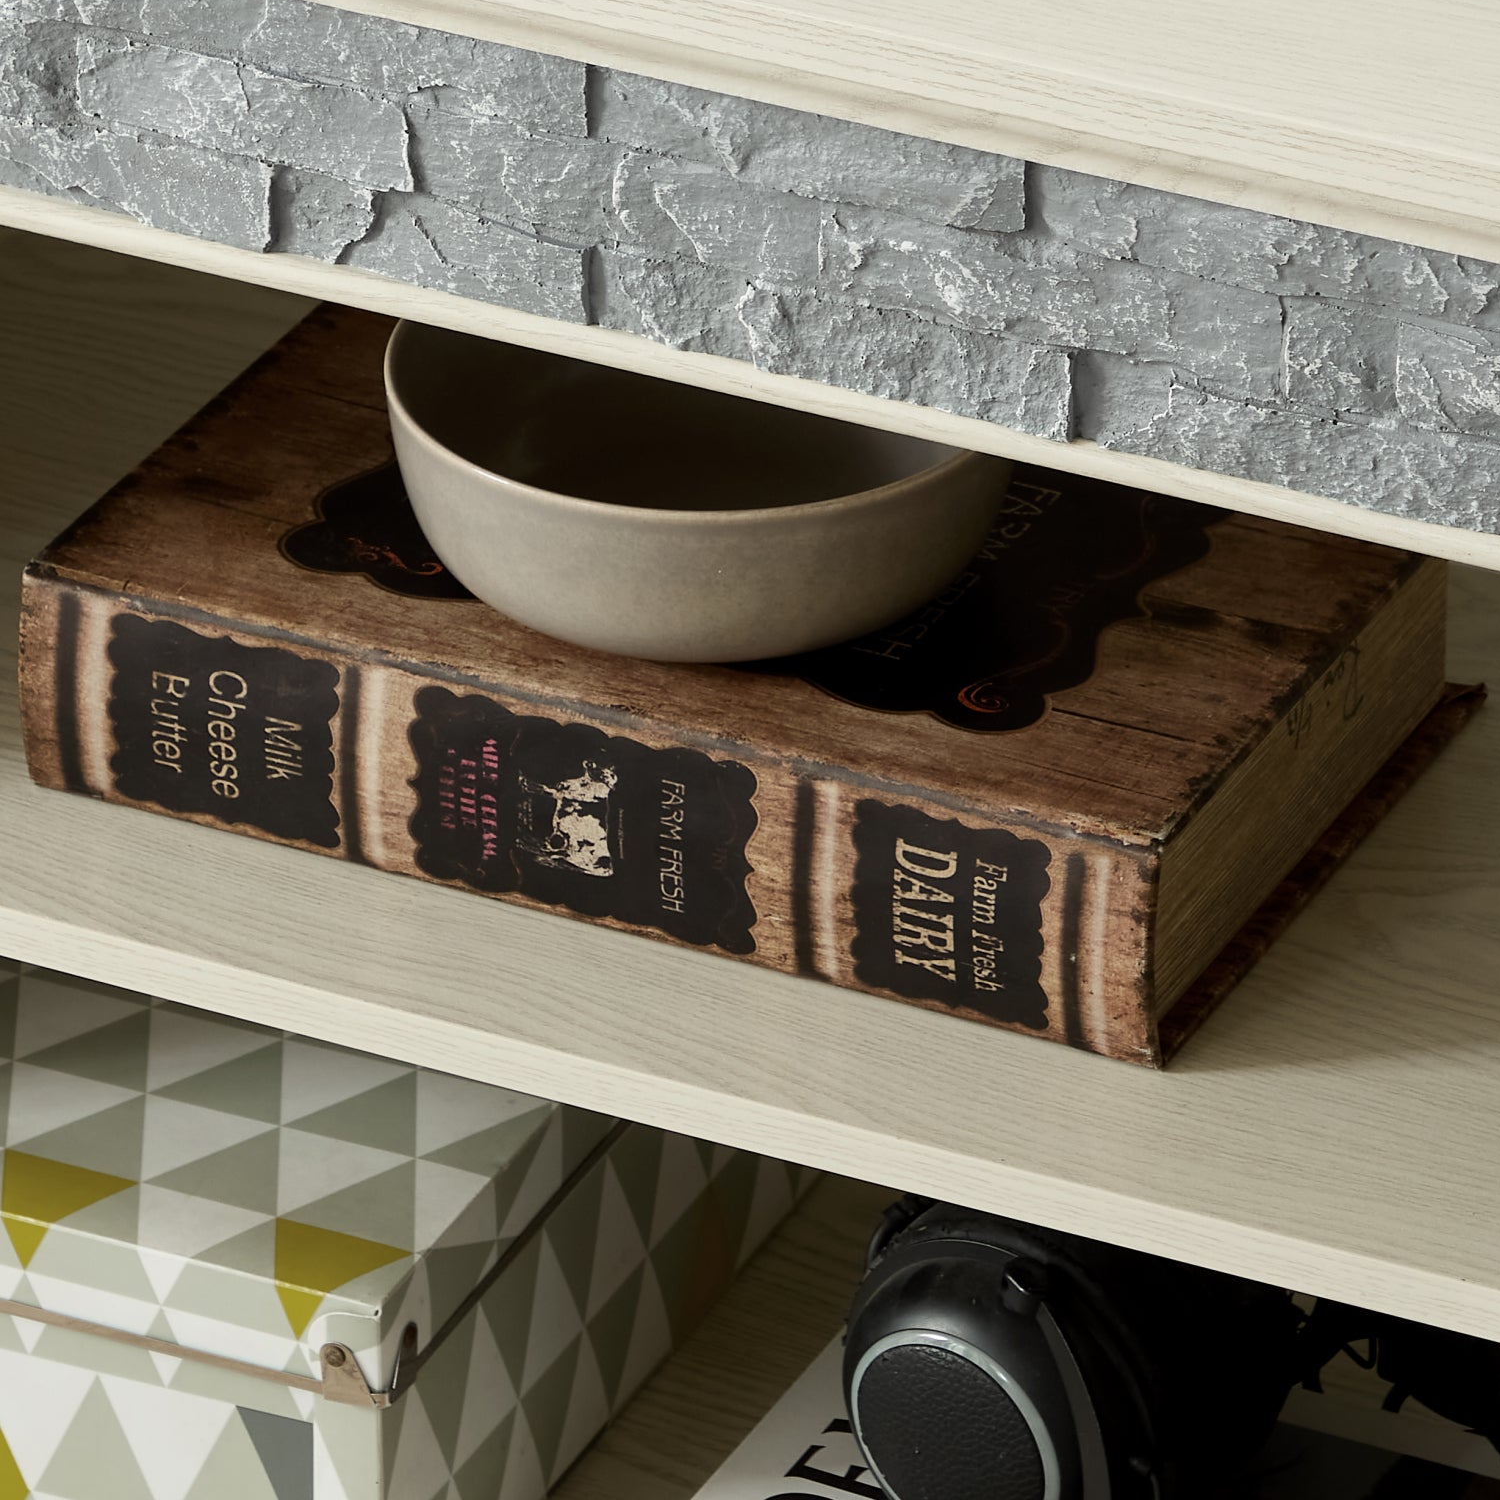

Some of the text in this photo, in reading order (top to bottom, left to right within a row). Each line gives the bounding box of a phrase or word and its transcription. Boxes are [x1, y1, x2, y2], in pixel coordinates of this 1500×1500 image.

[150, 671, 190, 773] Butter
[207, 670, 248, 799] Cheese
[264, 716, 303, 780] Milk
[659, 779, 686, 913] FARM FRESH
[892, 837, 959, 983] DAIRY
[971, 858, 1008, 991] Farm Fresh
